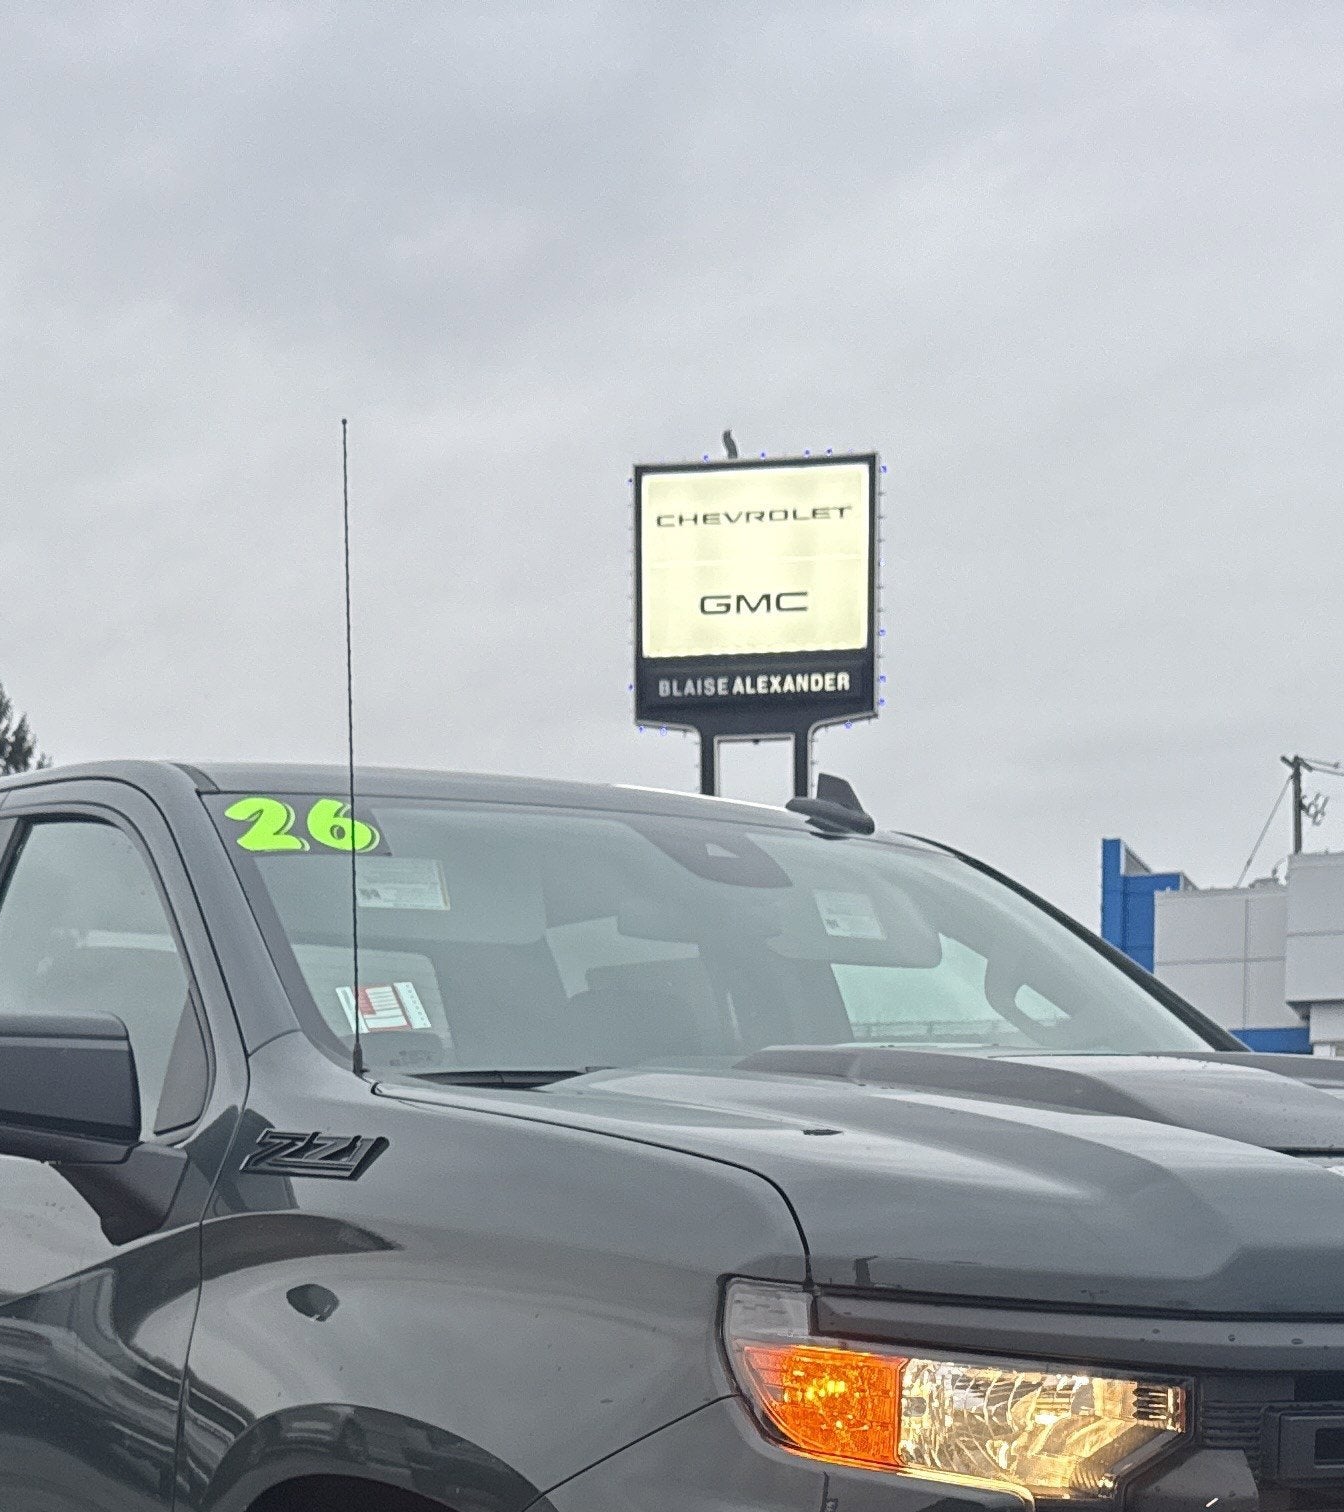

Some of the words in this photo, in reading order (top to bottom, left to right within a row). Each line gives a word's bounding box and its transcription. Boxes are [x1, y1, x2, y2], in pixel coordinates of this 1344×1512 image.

[656, 505, 853, 528] CHEVROLET
[699, 591, 808, 615] GMC
[658, 677, 730, 698] BLAISE
[731, 671, 850, 694] ALEXANDER
[224, 797, 381, 853] 26
